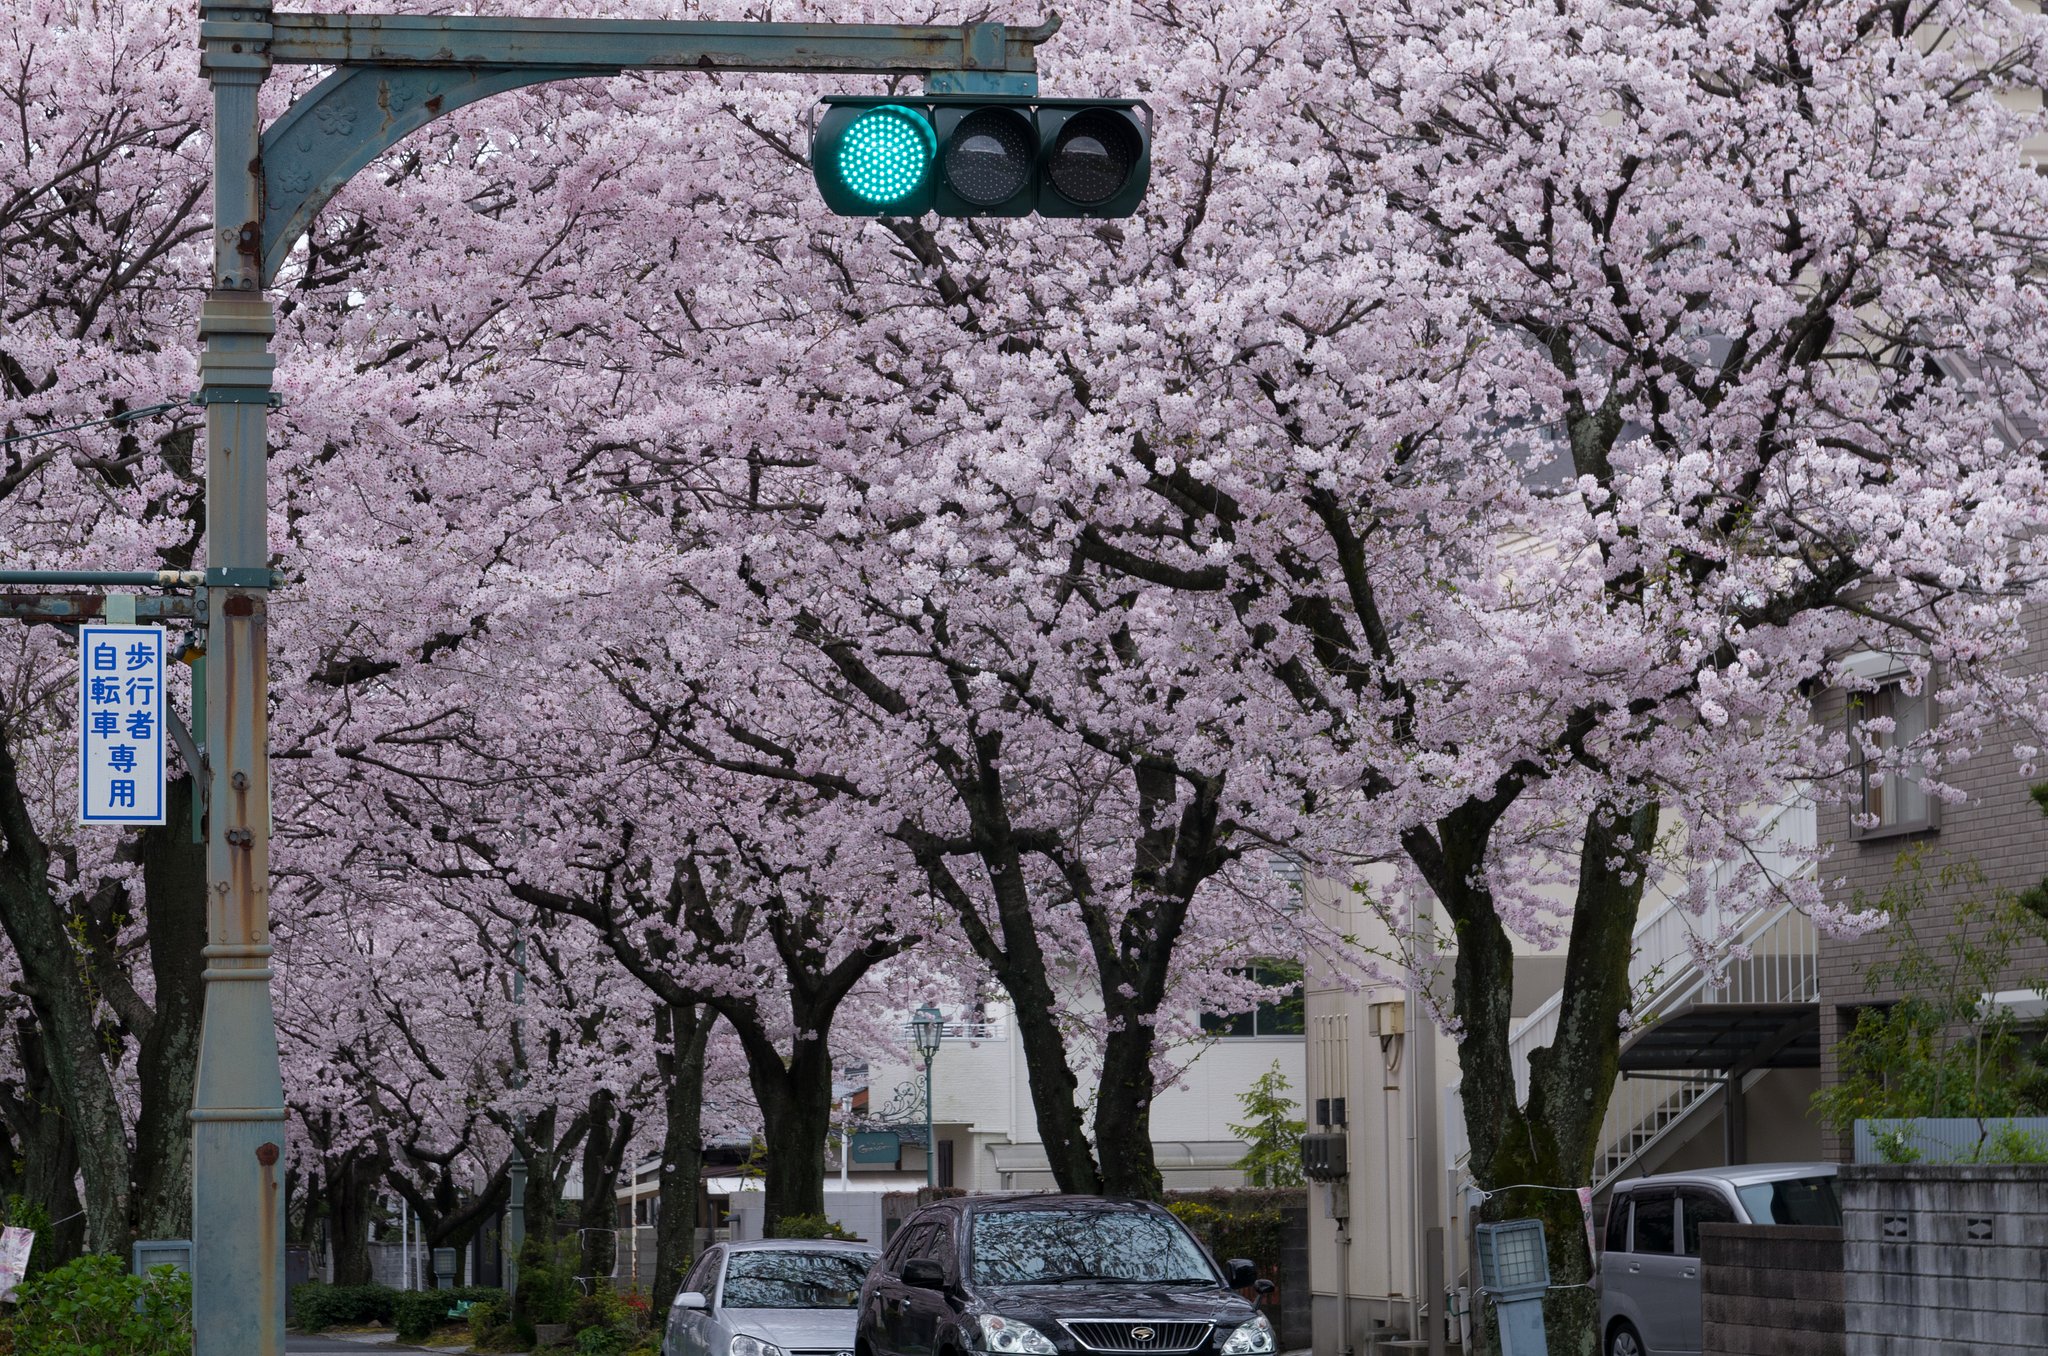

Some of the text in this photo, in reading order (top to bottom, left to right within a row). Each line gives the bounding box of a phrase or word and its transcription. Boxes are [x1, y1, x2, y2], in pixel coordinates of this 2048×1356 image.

[90, 641, 121, 739] 自転車
[125, 641, 155, 739] 歩行者
[108, 743, 137, 808] 専用
